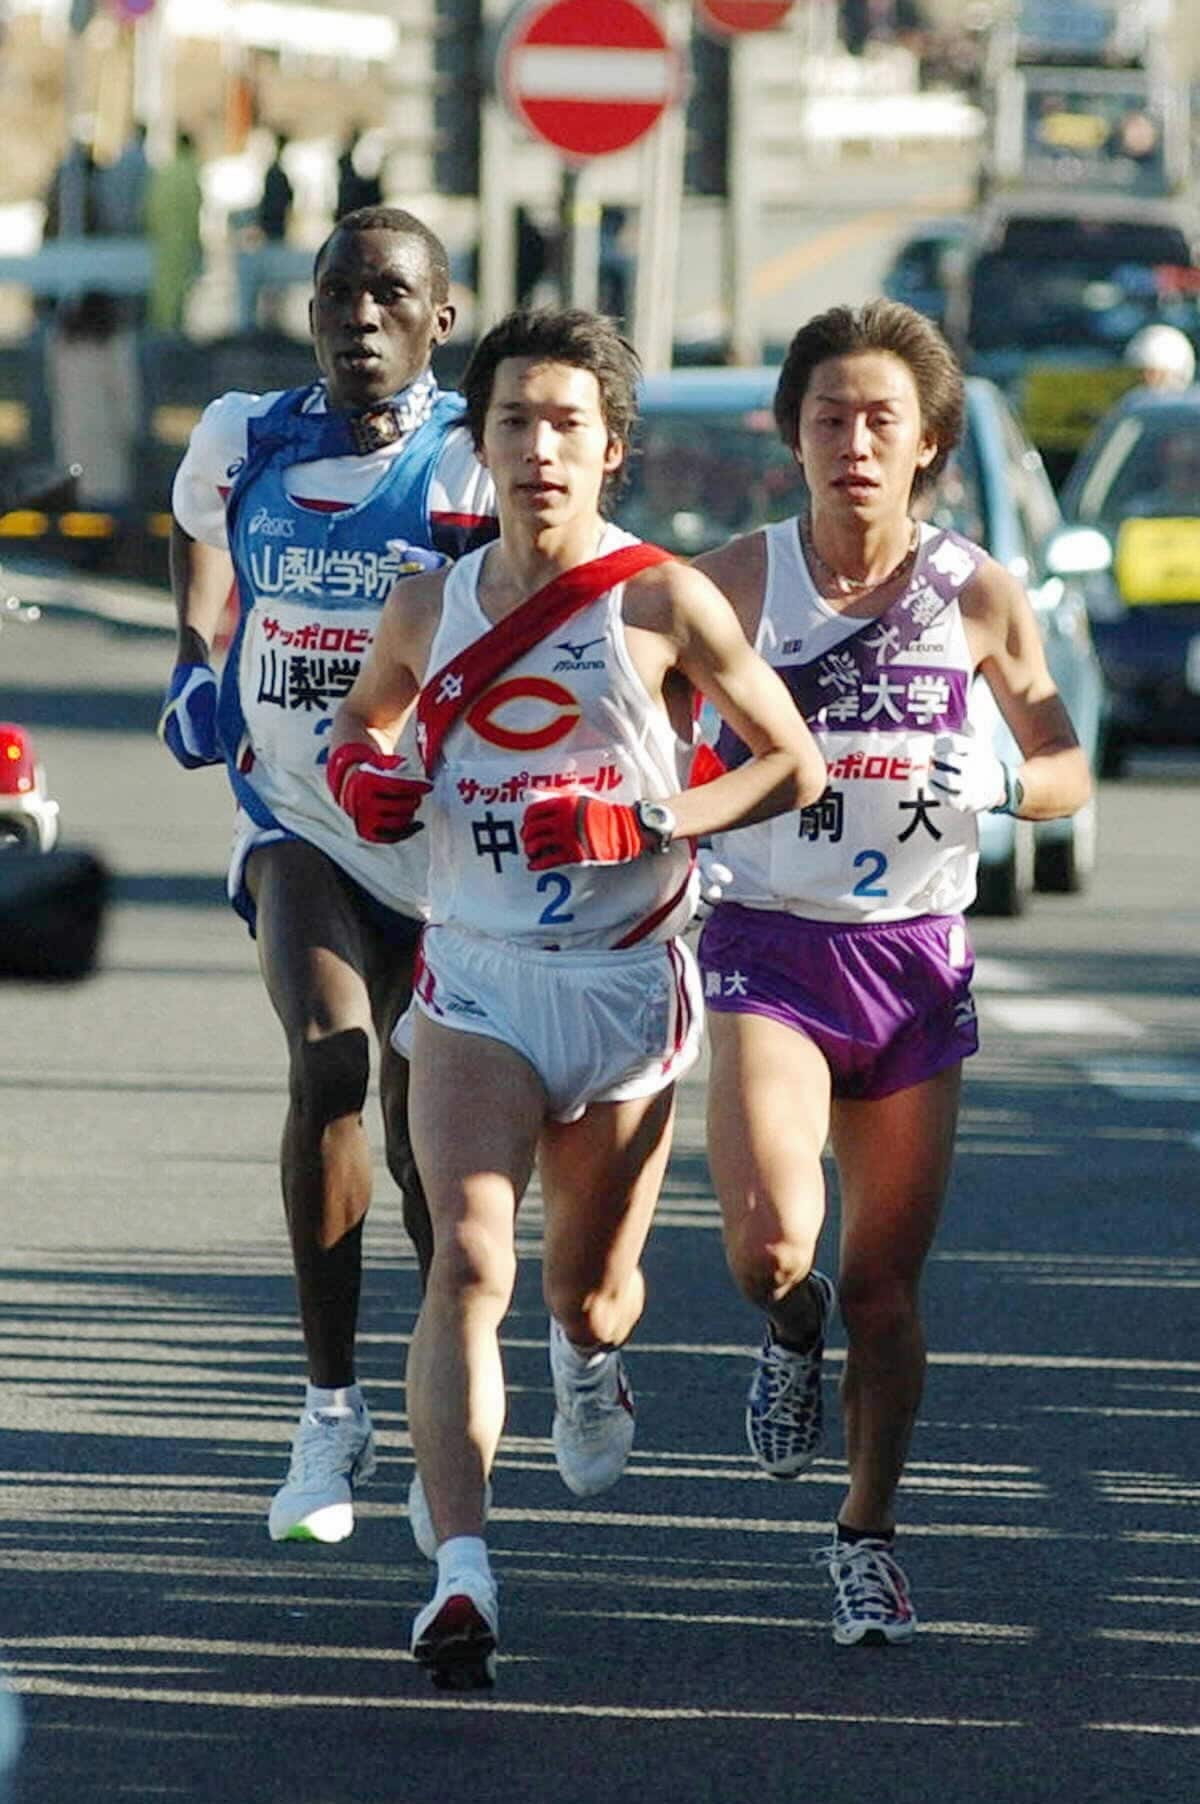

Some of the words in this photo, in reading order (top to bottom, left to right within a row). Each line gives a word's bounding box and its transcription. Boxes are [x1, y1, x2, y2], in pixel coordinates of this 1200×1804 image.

[251, 544, 399, 599] 山梨学院
[536, 872, 574, 925] 2
[853, 850, 888, 897] 2
